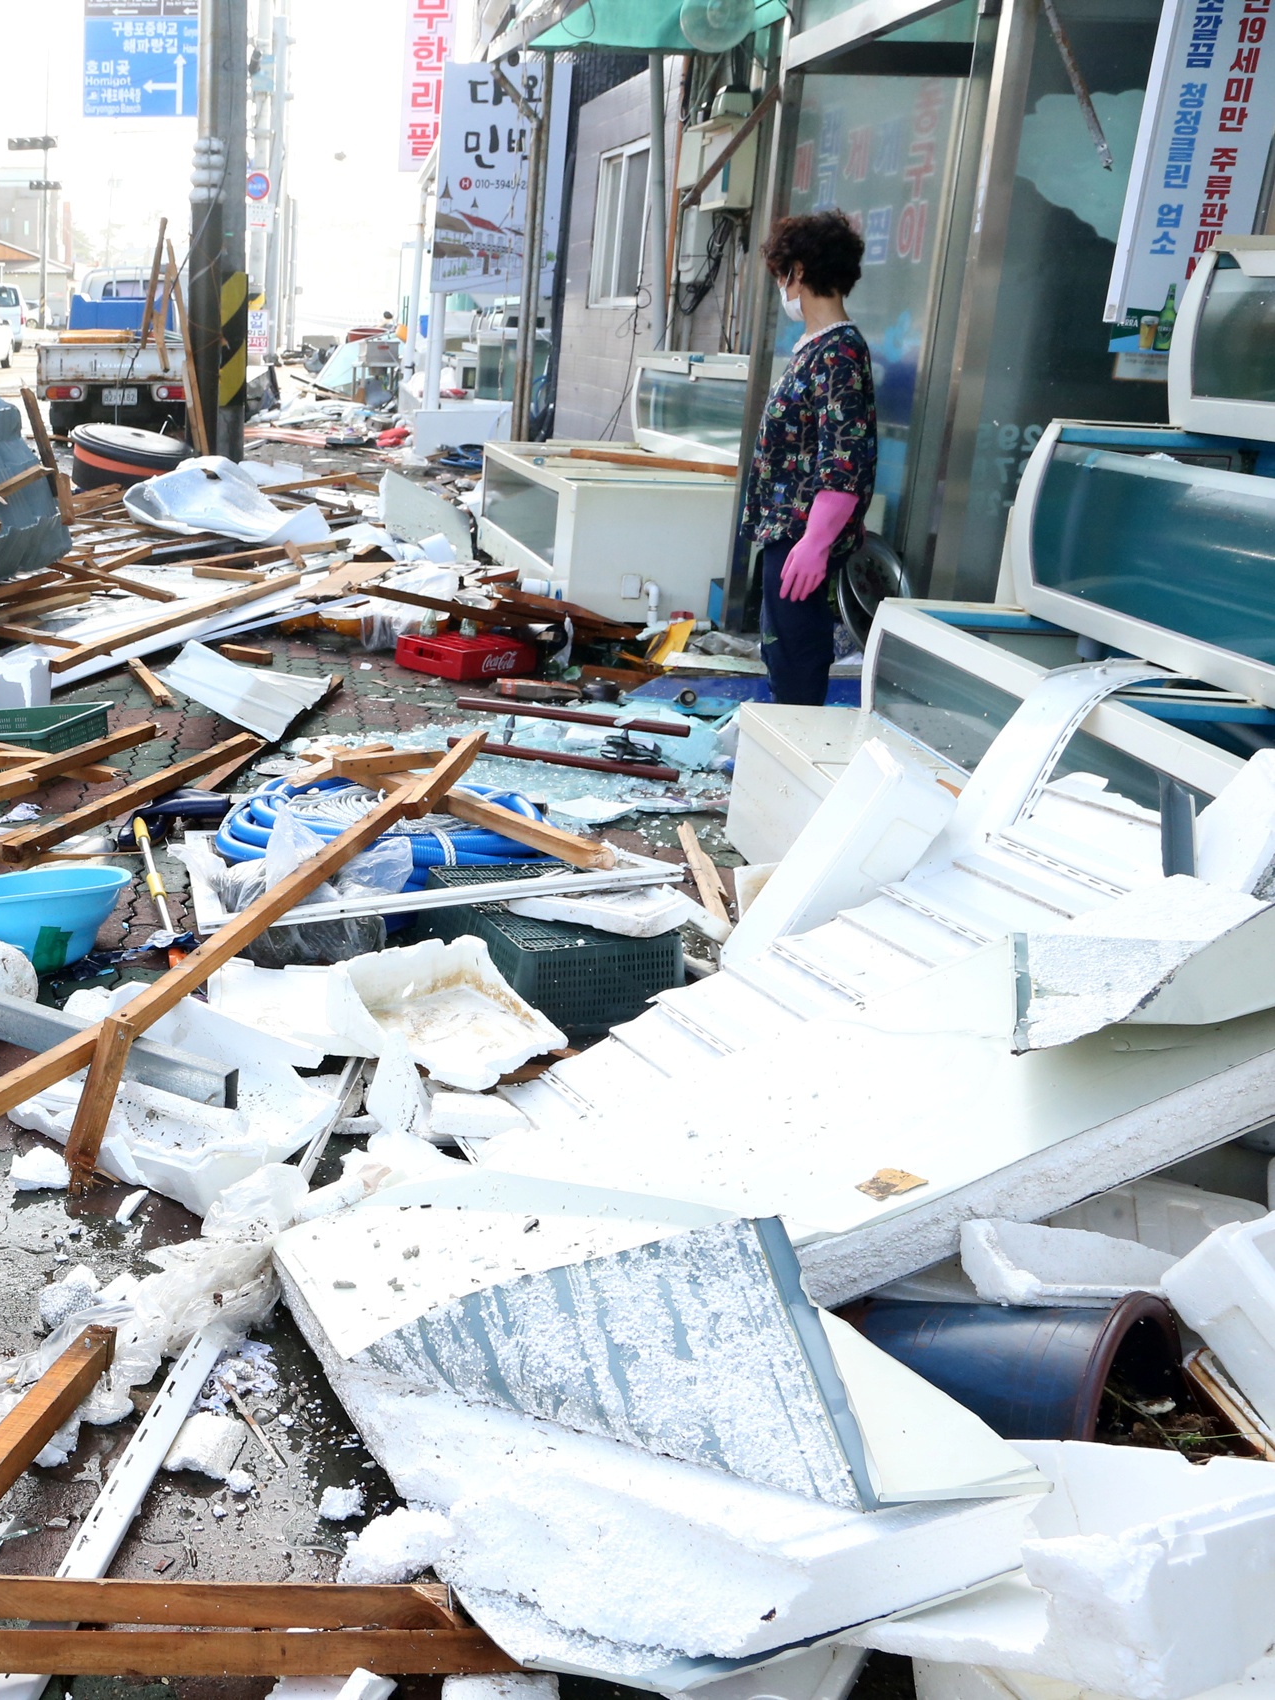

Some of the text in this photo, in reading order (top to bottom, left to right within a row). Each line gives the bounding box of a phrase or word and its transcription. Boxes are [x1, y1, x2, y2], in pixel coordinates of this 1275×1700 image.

[112, 21, 178, 37] 구룡포중학교
[122, 38, 177, 54] 해파랑길
[85, 76, 132, 87] Homigot
[1162, 83, 1208, 189] 청정클린
[1149, 203, 1184, 255] 업소
